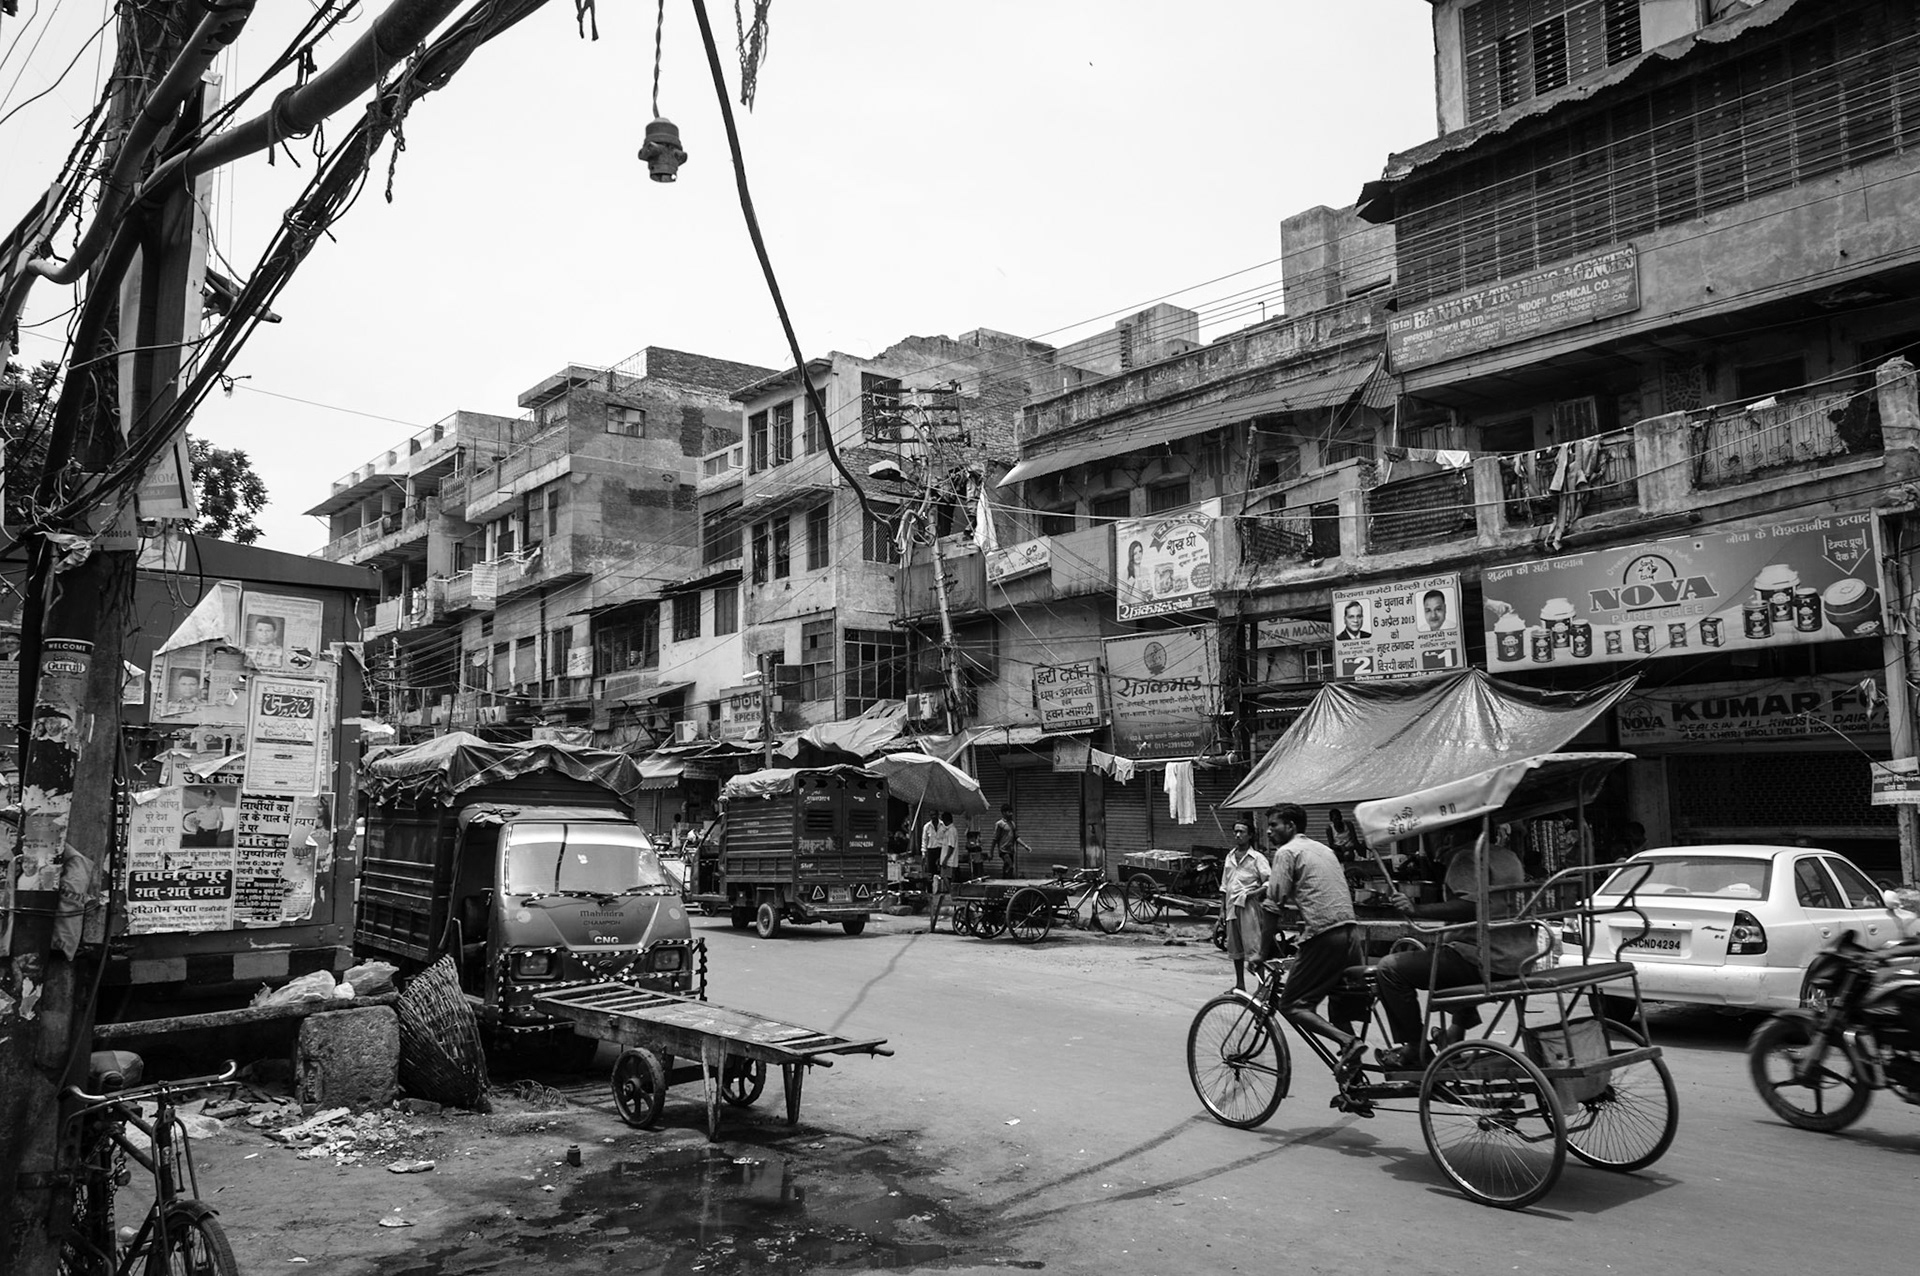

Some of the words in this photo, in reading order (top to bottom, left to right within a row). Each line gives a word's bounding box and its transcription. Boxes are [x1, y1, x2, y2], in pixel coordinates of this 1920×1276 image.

[1551, 283, 1591, 304] CHEMICAL
[1755, 526, 1766, 540] के
[1772, 518, 1830, 537] विश्वसनीय
[1837, 512, 1871, 528] उत्पाद
[1487, 566, 1513, 583] शुद्धता
[1516, 563, 1529, 576] की
[1533, 561, 1550, 574] सही
[1553, 558, 1584, 570] पहचान
[1589, 575, 1718, 613] NOVA
[1374, 596, 1382, 608] के
[1384, 596, 1404, 613] चुनाव
[1406, 592, 1415, 605] में
[1373, 617, 1379, 627] 6
[1401, 615, 1415, 625] 2013
[1611, 609, 1651, 625] PURE
[1659, 604, 1705, 619] GHEE
[48, 643, 86, 652] WELCOME
[1438, 649, 1453, 667] 1
[1353, 656, 1372, 675] 2
[732, 695, 762, 708] MDH
[1671, 692, 1821, 722] KUMAR
[734, 711, 762, 722] SPICES
[1621, 716, 1665, 730] NOVA
[1768, 715, 1806, 727] KINDS
[135, 871, 179, 882] तपन
[180, 870, 229, 884] कपूर
[135, 887, 192, 900] शत्-शत्
[193, 886, 226, 896] नमन
[173, 905, 197, 914] गुप्ता
[580, 910, 624, 918] Mahindra
[594, 936, 620, 944] CNG
